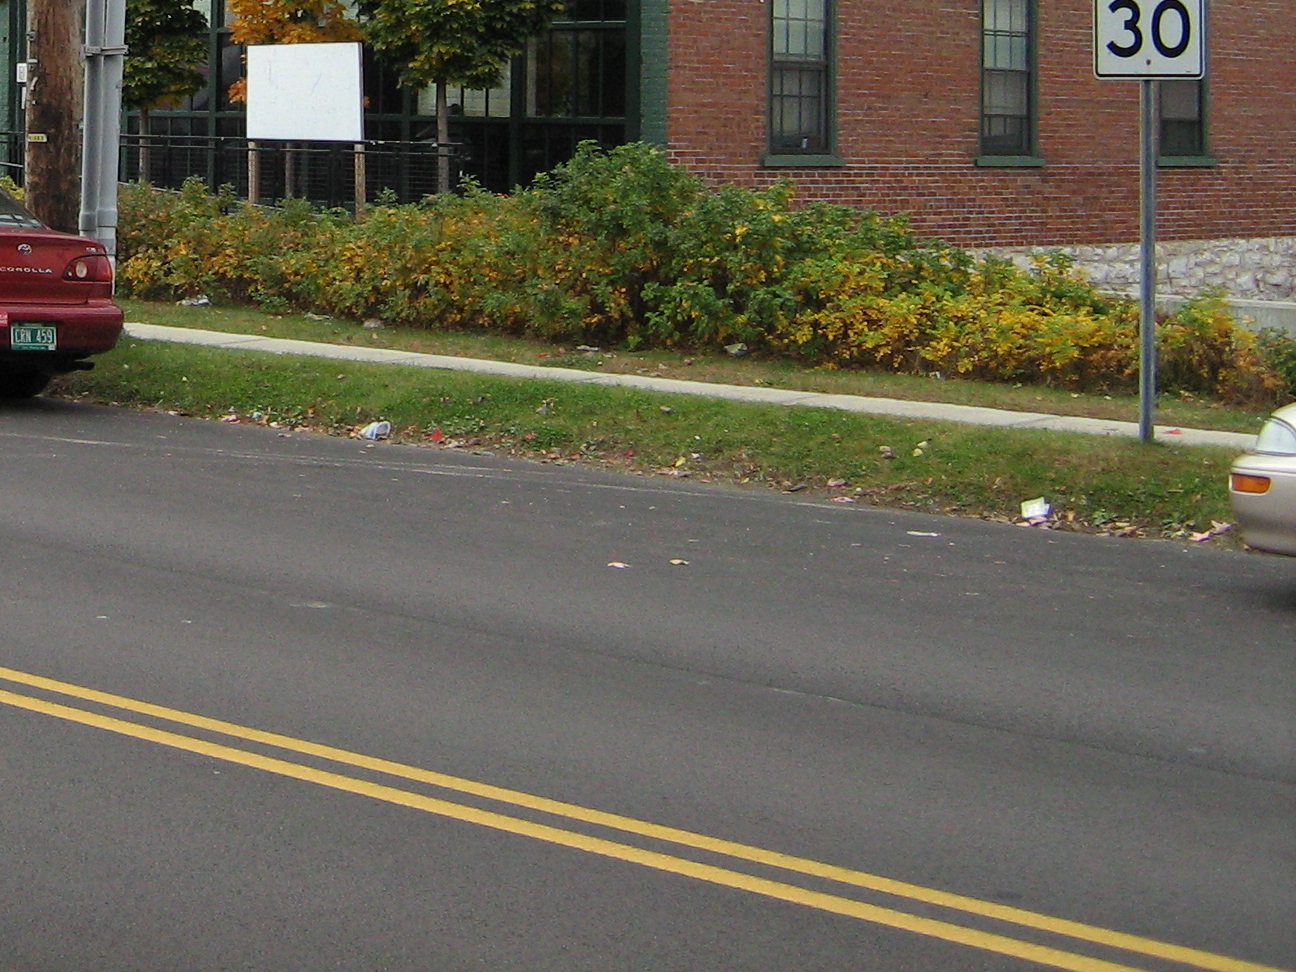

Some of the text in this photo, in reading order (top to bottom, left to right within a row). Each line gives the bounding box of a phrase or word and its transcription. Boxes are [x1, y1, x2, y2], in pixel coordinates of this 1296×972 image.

[0, 266, 53, 274] COROLLA
[15, 329, 53, 344] CRN 459
